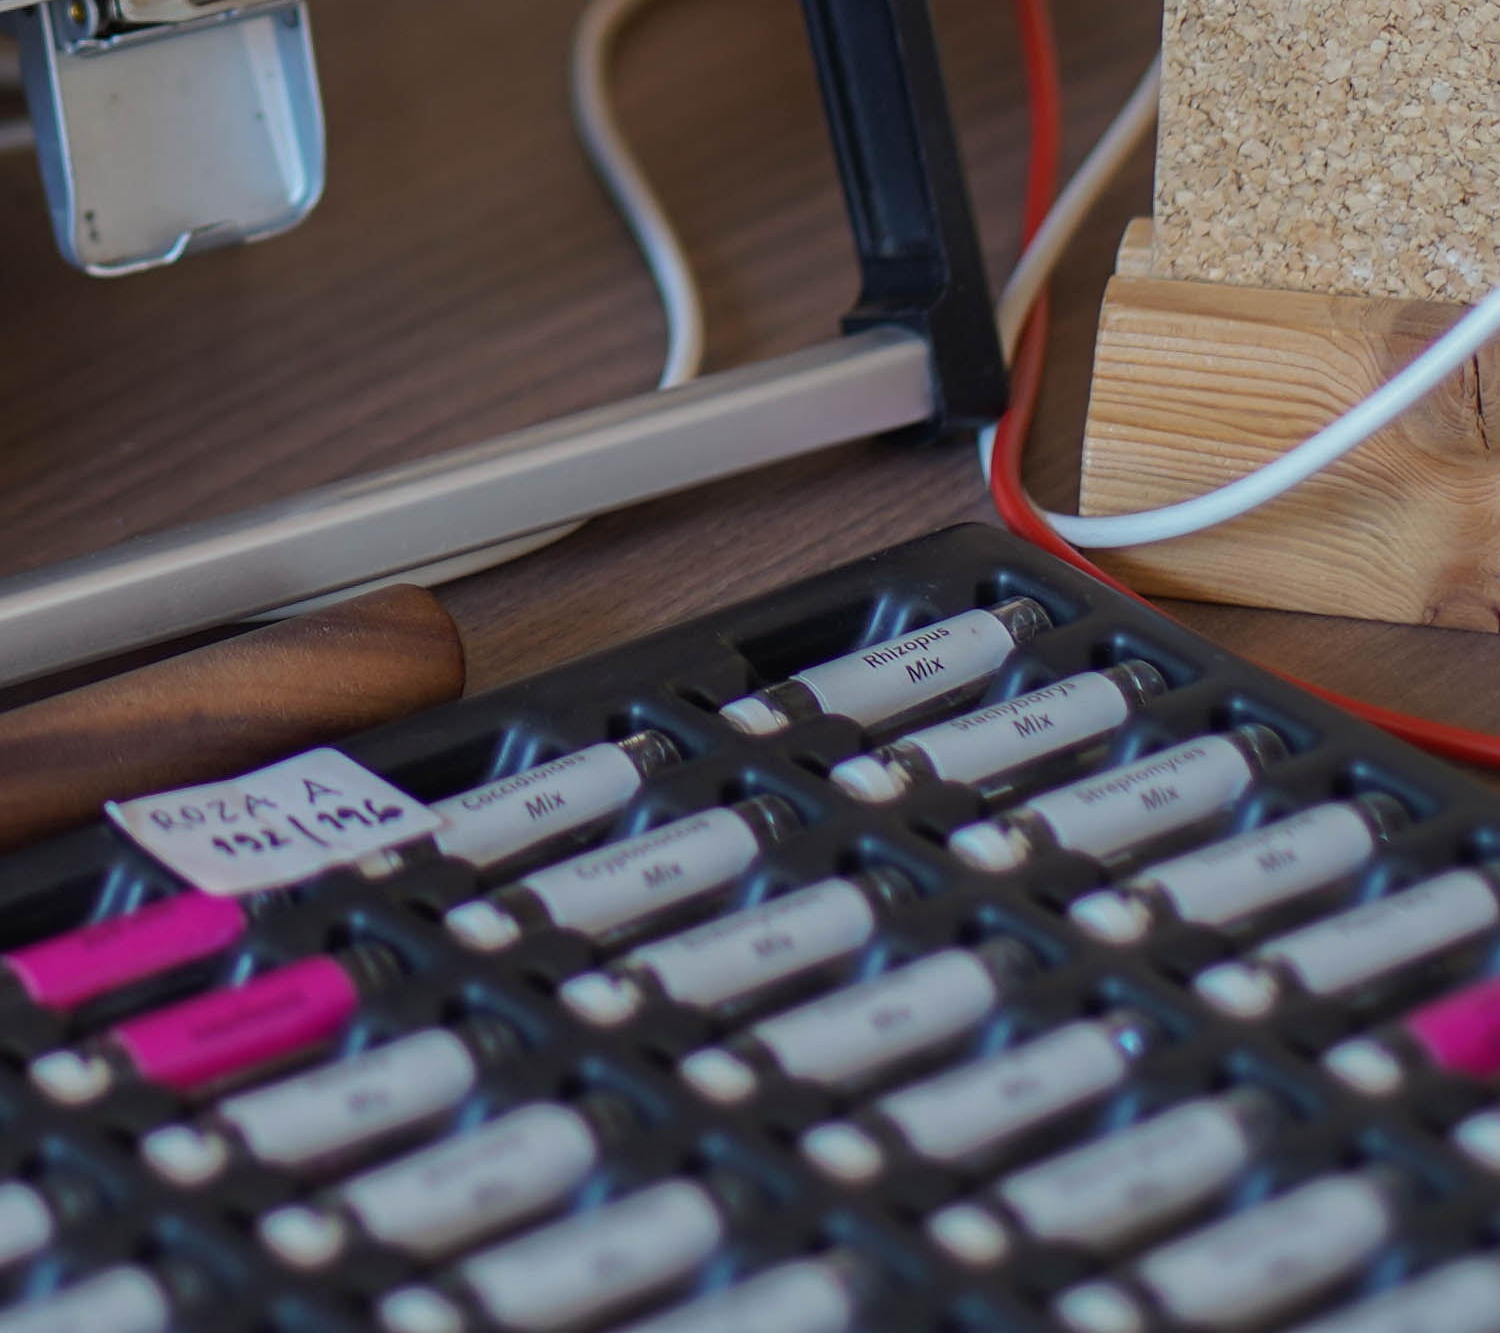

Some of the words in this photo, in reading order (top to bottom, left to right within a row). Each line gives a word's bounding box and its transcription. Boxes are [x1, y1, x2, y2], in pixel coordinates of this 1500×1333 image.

[862, 626, 950, 669] Rhizopus
[905, 657, 945, 684] Mix
[1013, 713, 1055, 738] Mix
[302, 778, 342, 805] A
[1139, 785, 1180, 811] Mix
[524, 791, 566, 820] Mix
[642, 862, 683, 889] Mix
